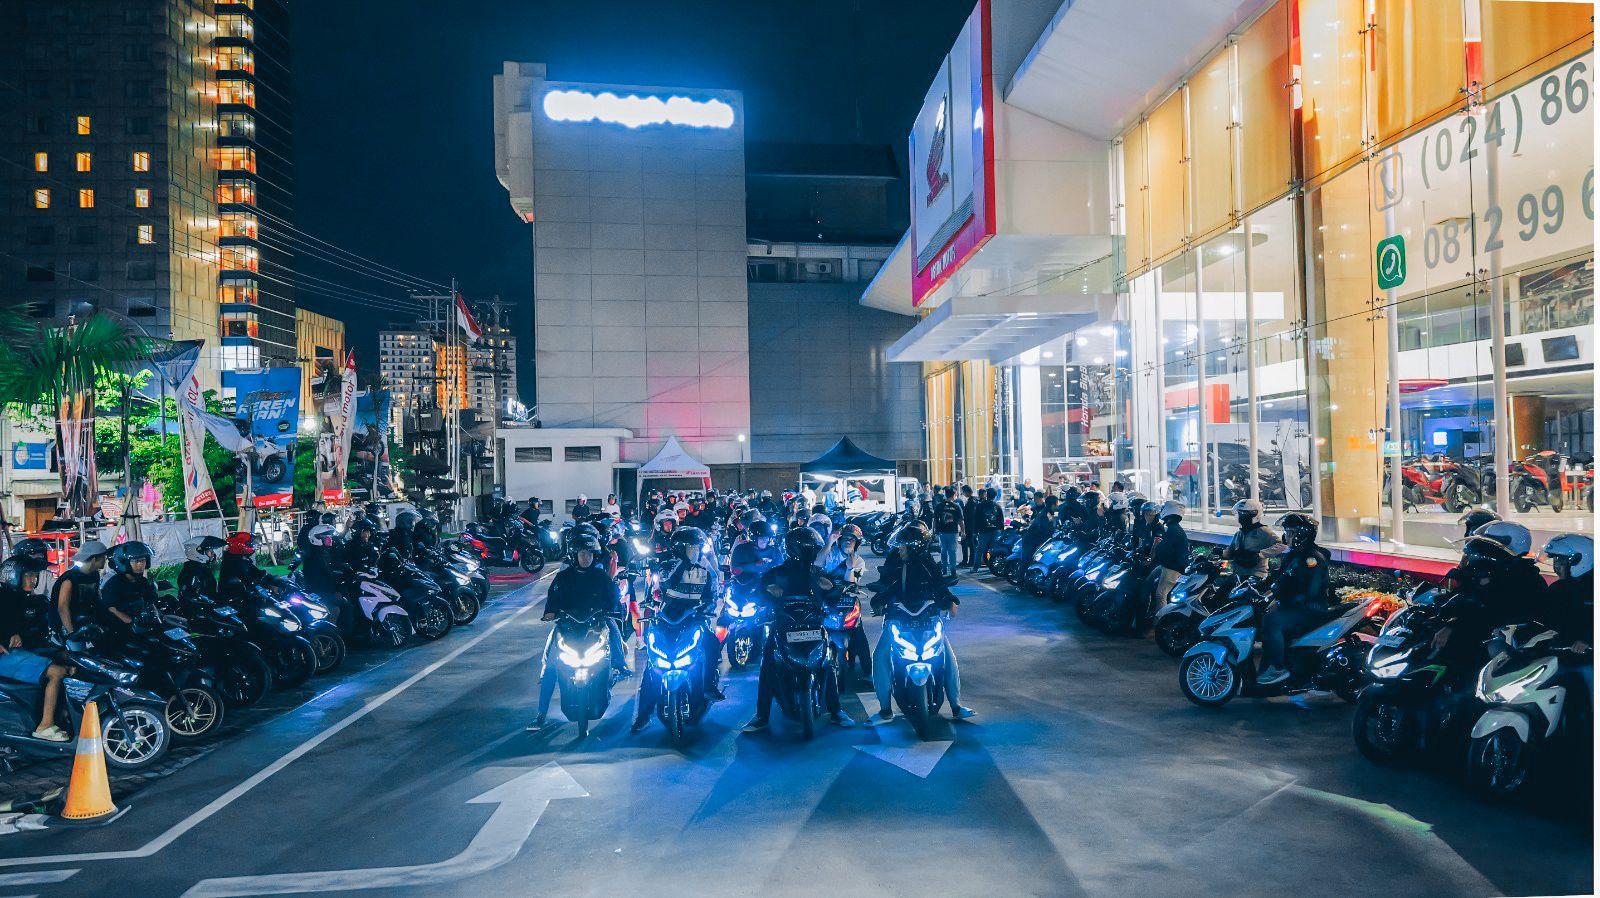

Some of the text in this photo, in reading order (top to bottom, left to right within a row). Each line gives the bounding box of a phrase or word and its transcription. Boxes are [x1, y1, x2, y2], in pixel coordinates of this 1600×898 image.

[1421, 61, 1594, 190] (024) 86
[1423, 205, 1504, 270] 0812
[1517, 184, 1565, 242] 99
[1080, 391, 1089, 428] Honda
